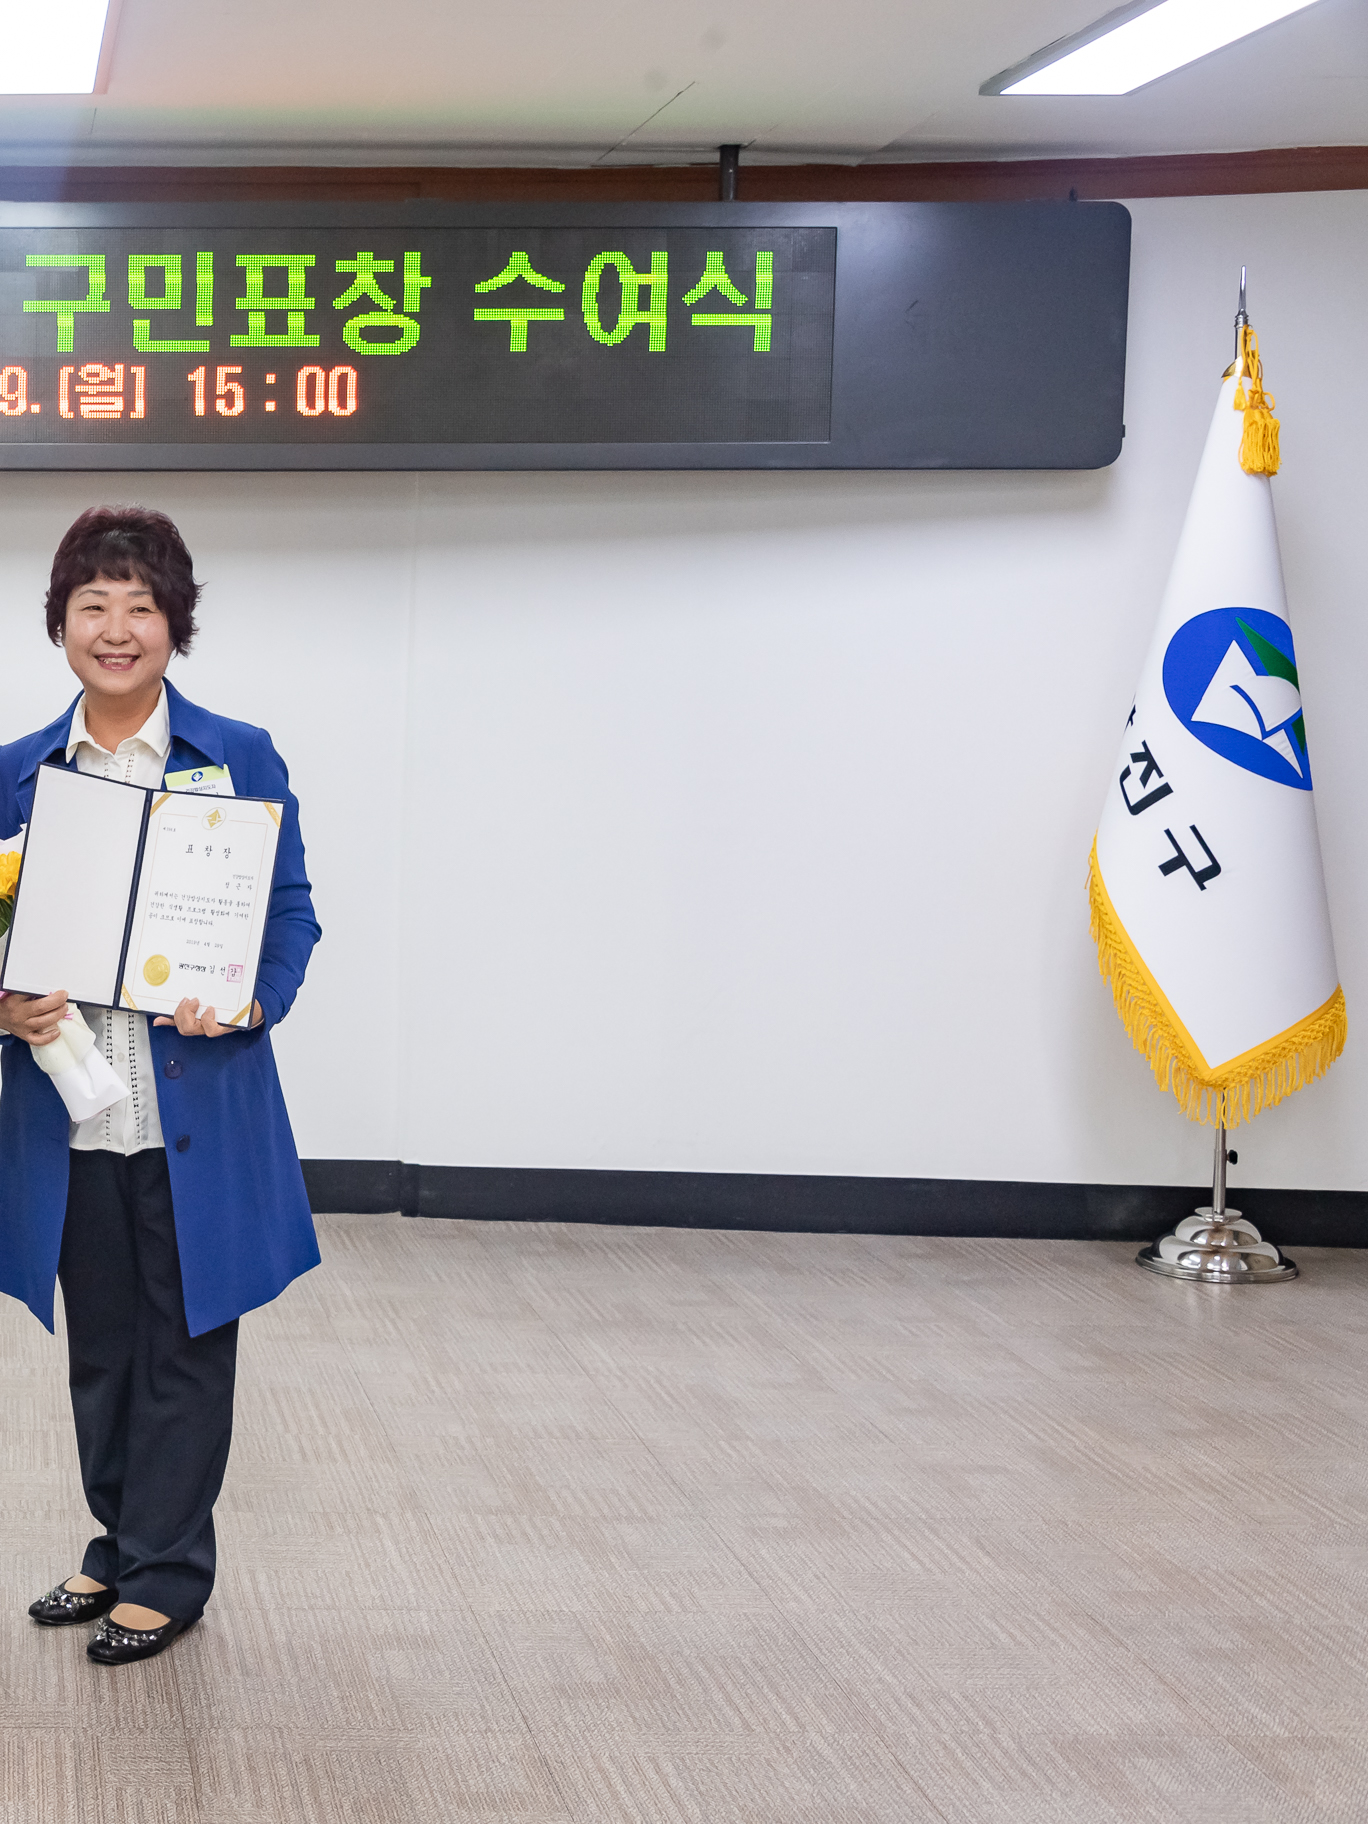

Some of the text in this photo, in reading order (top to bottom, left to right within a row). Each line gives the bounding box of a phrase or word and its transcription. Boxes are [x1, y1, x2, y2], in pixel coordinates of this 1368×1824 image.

[23, 251, 431, 355] 구민표창
[474, 251, 773, 352] 수여식
[1119, 692, 1222, 891] 진구
